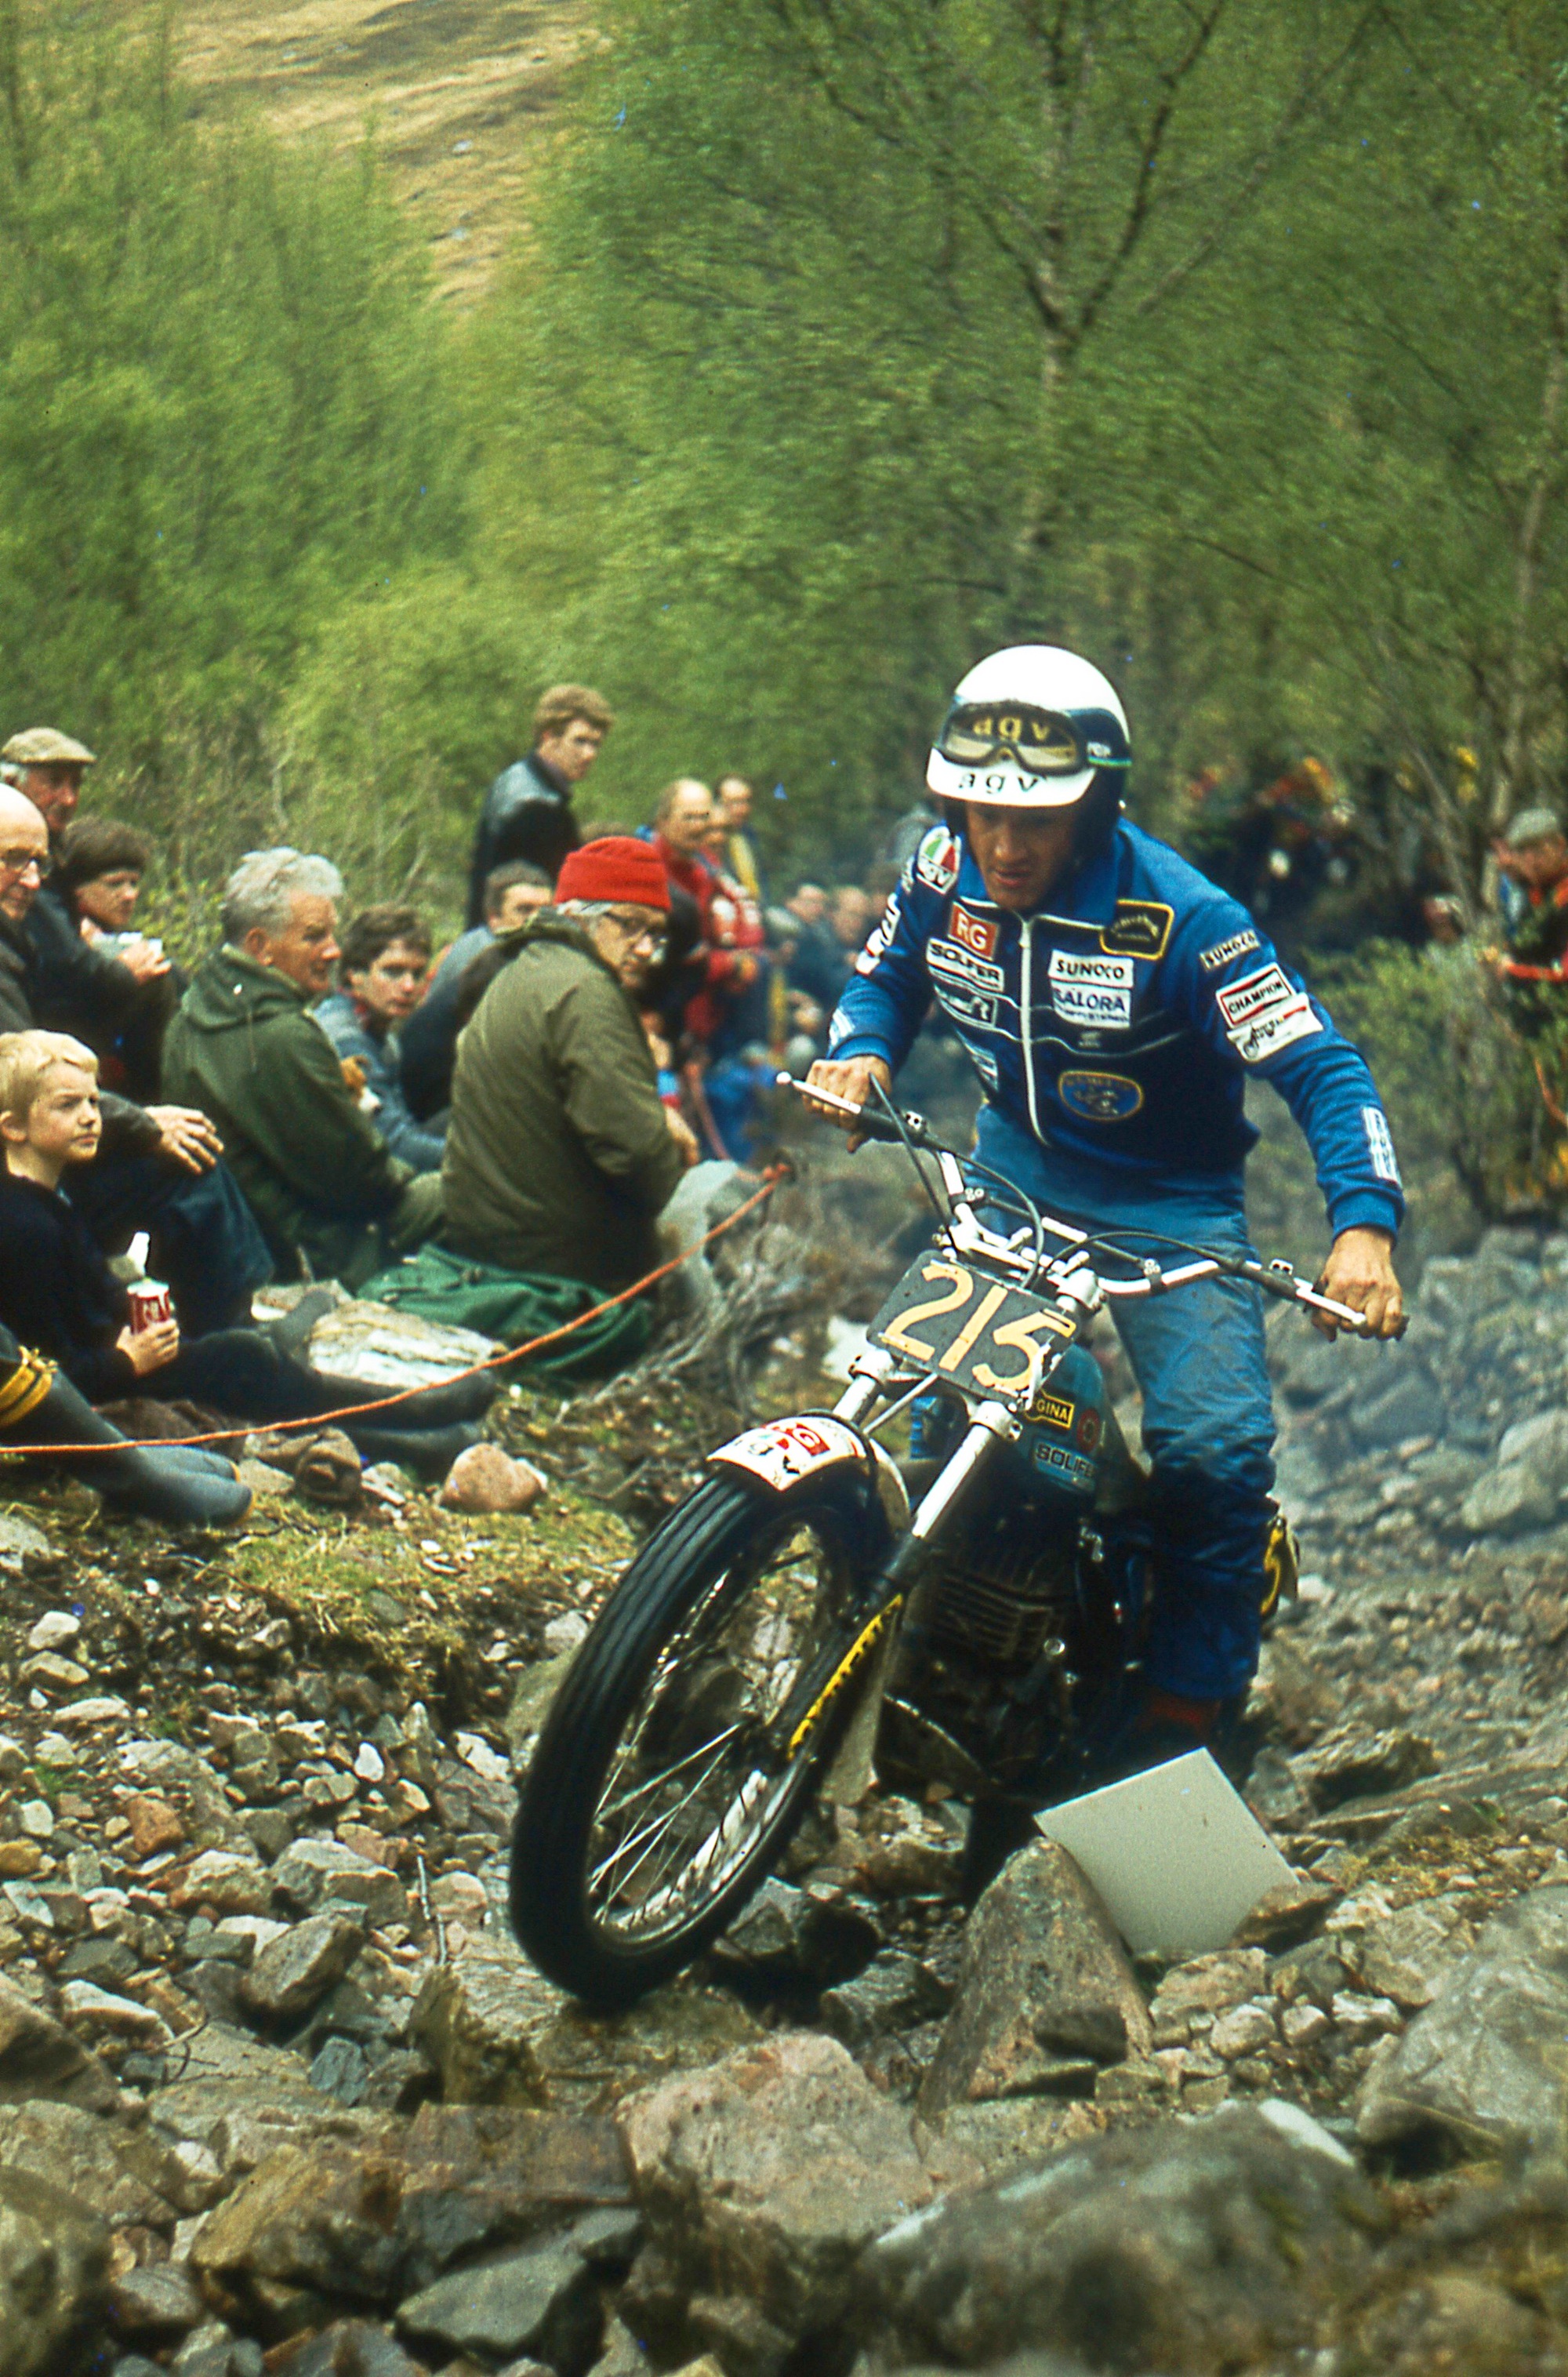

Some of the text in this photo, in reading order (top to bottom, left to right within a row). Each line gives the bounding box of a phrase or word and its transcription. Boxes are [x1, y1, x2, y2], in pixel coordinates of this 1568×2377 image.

[957, 912, 987, 950] RG
[1056, 959, 1125, 980] SUNOCO
[1053, 987, 1126, 1012] SALORA
[1229, 981, 1283, 1014] CHAMPION
[880, 1259, 1076, 1395] 215
[1036, 1398, 1069, 1421] GINA
